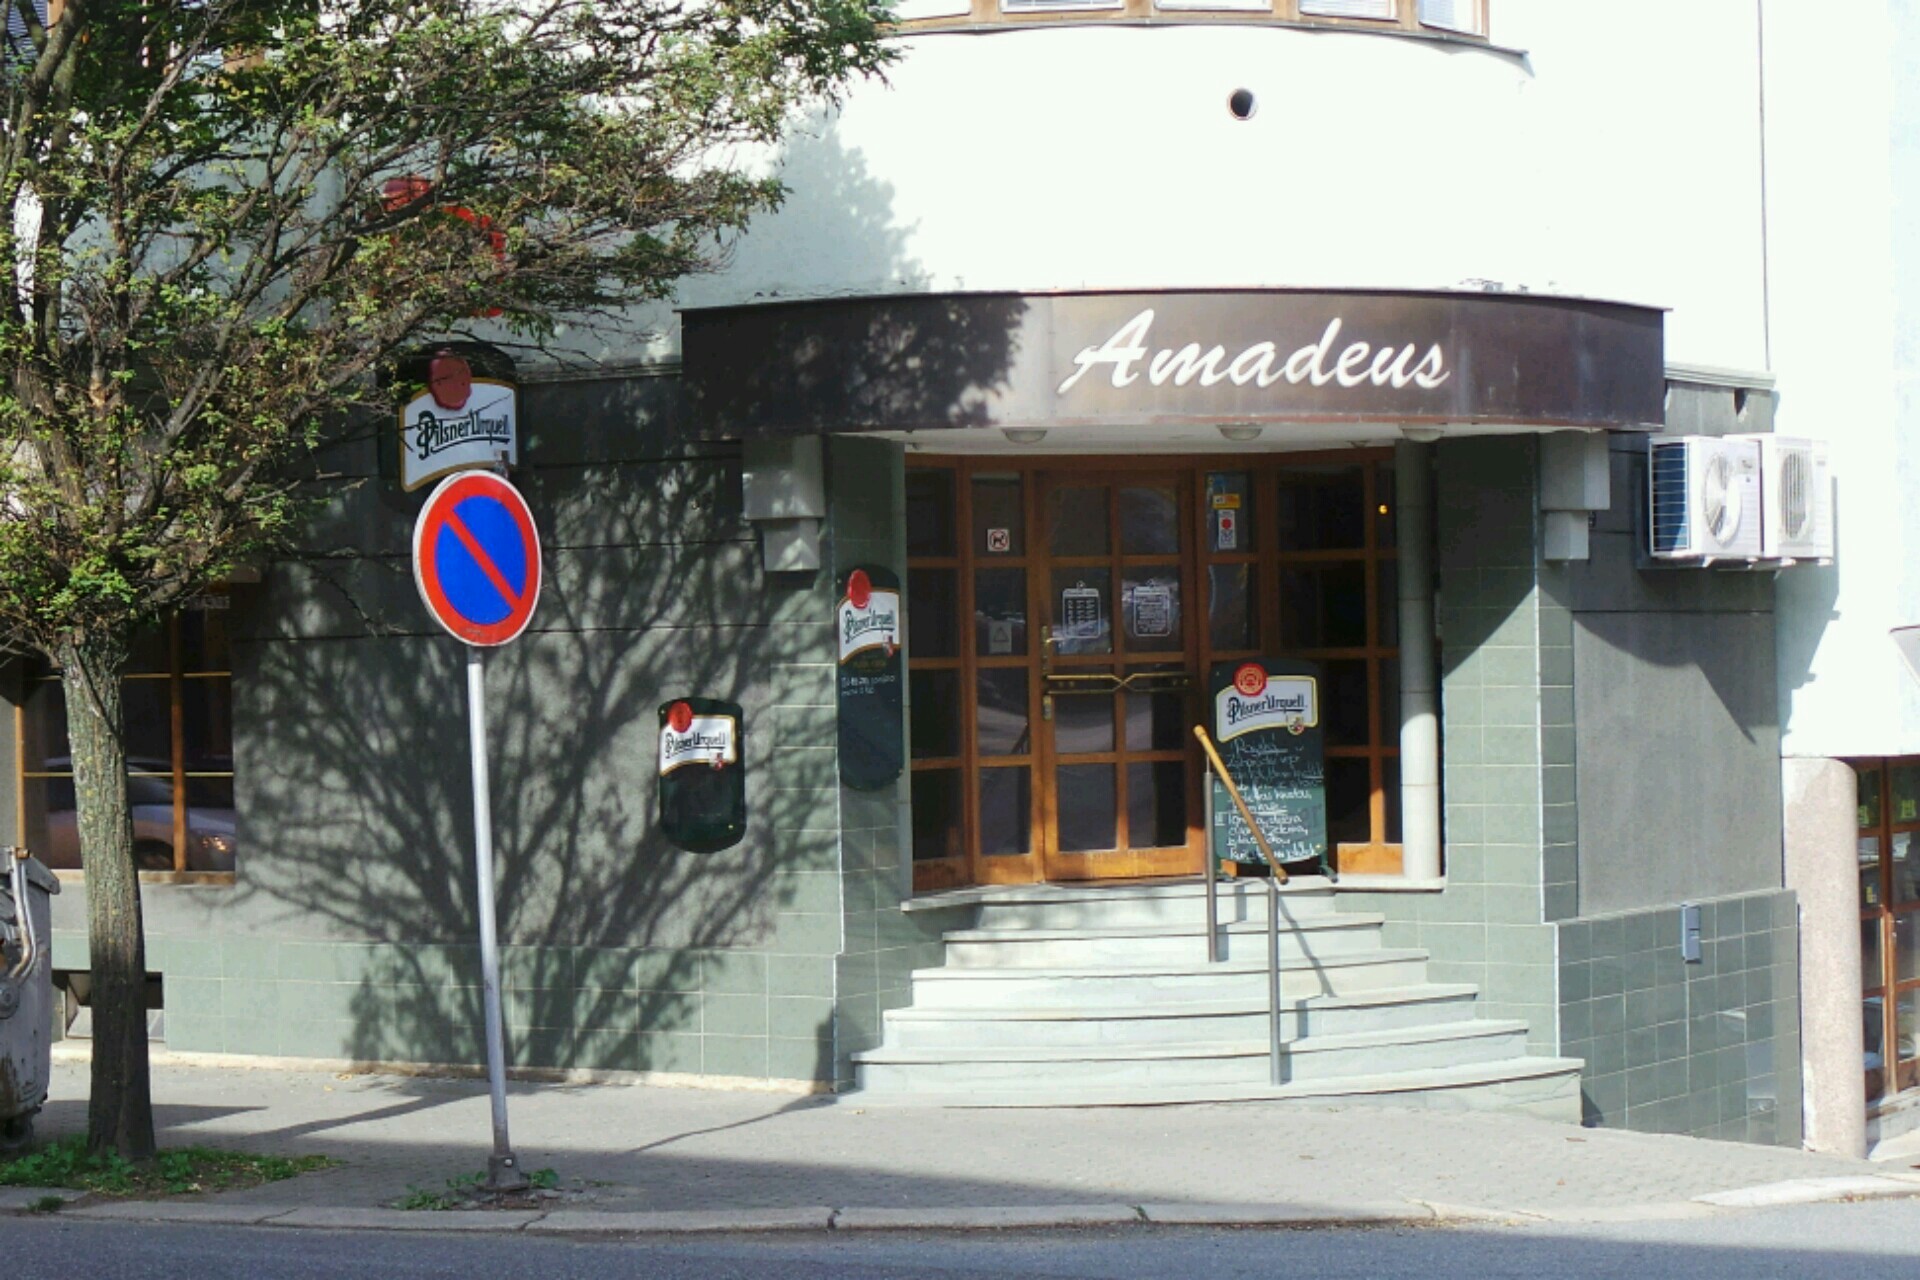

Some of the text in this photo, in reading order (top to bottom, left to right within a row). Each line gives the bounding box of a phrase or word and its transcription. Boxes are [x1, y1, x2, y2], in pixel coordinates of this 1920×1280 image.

[1057, 307, 1452, 395] Amadeus
[416, 409, 510, 460] Pilsner Urquell
[1226, 693, 1306, 726] Pilsner Urquell
[692, 731, 726, 751] Urquell
